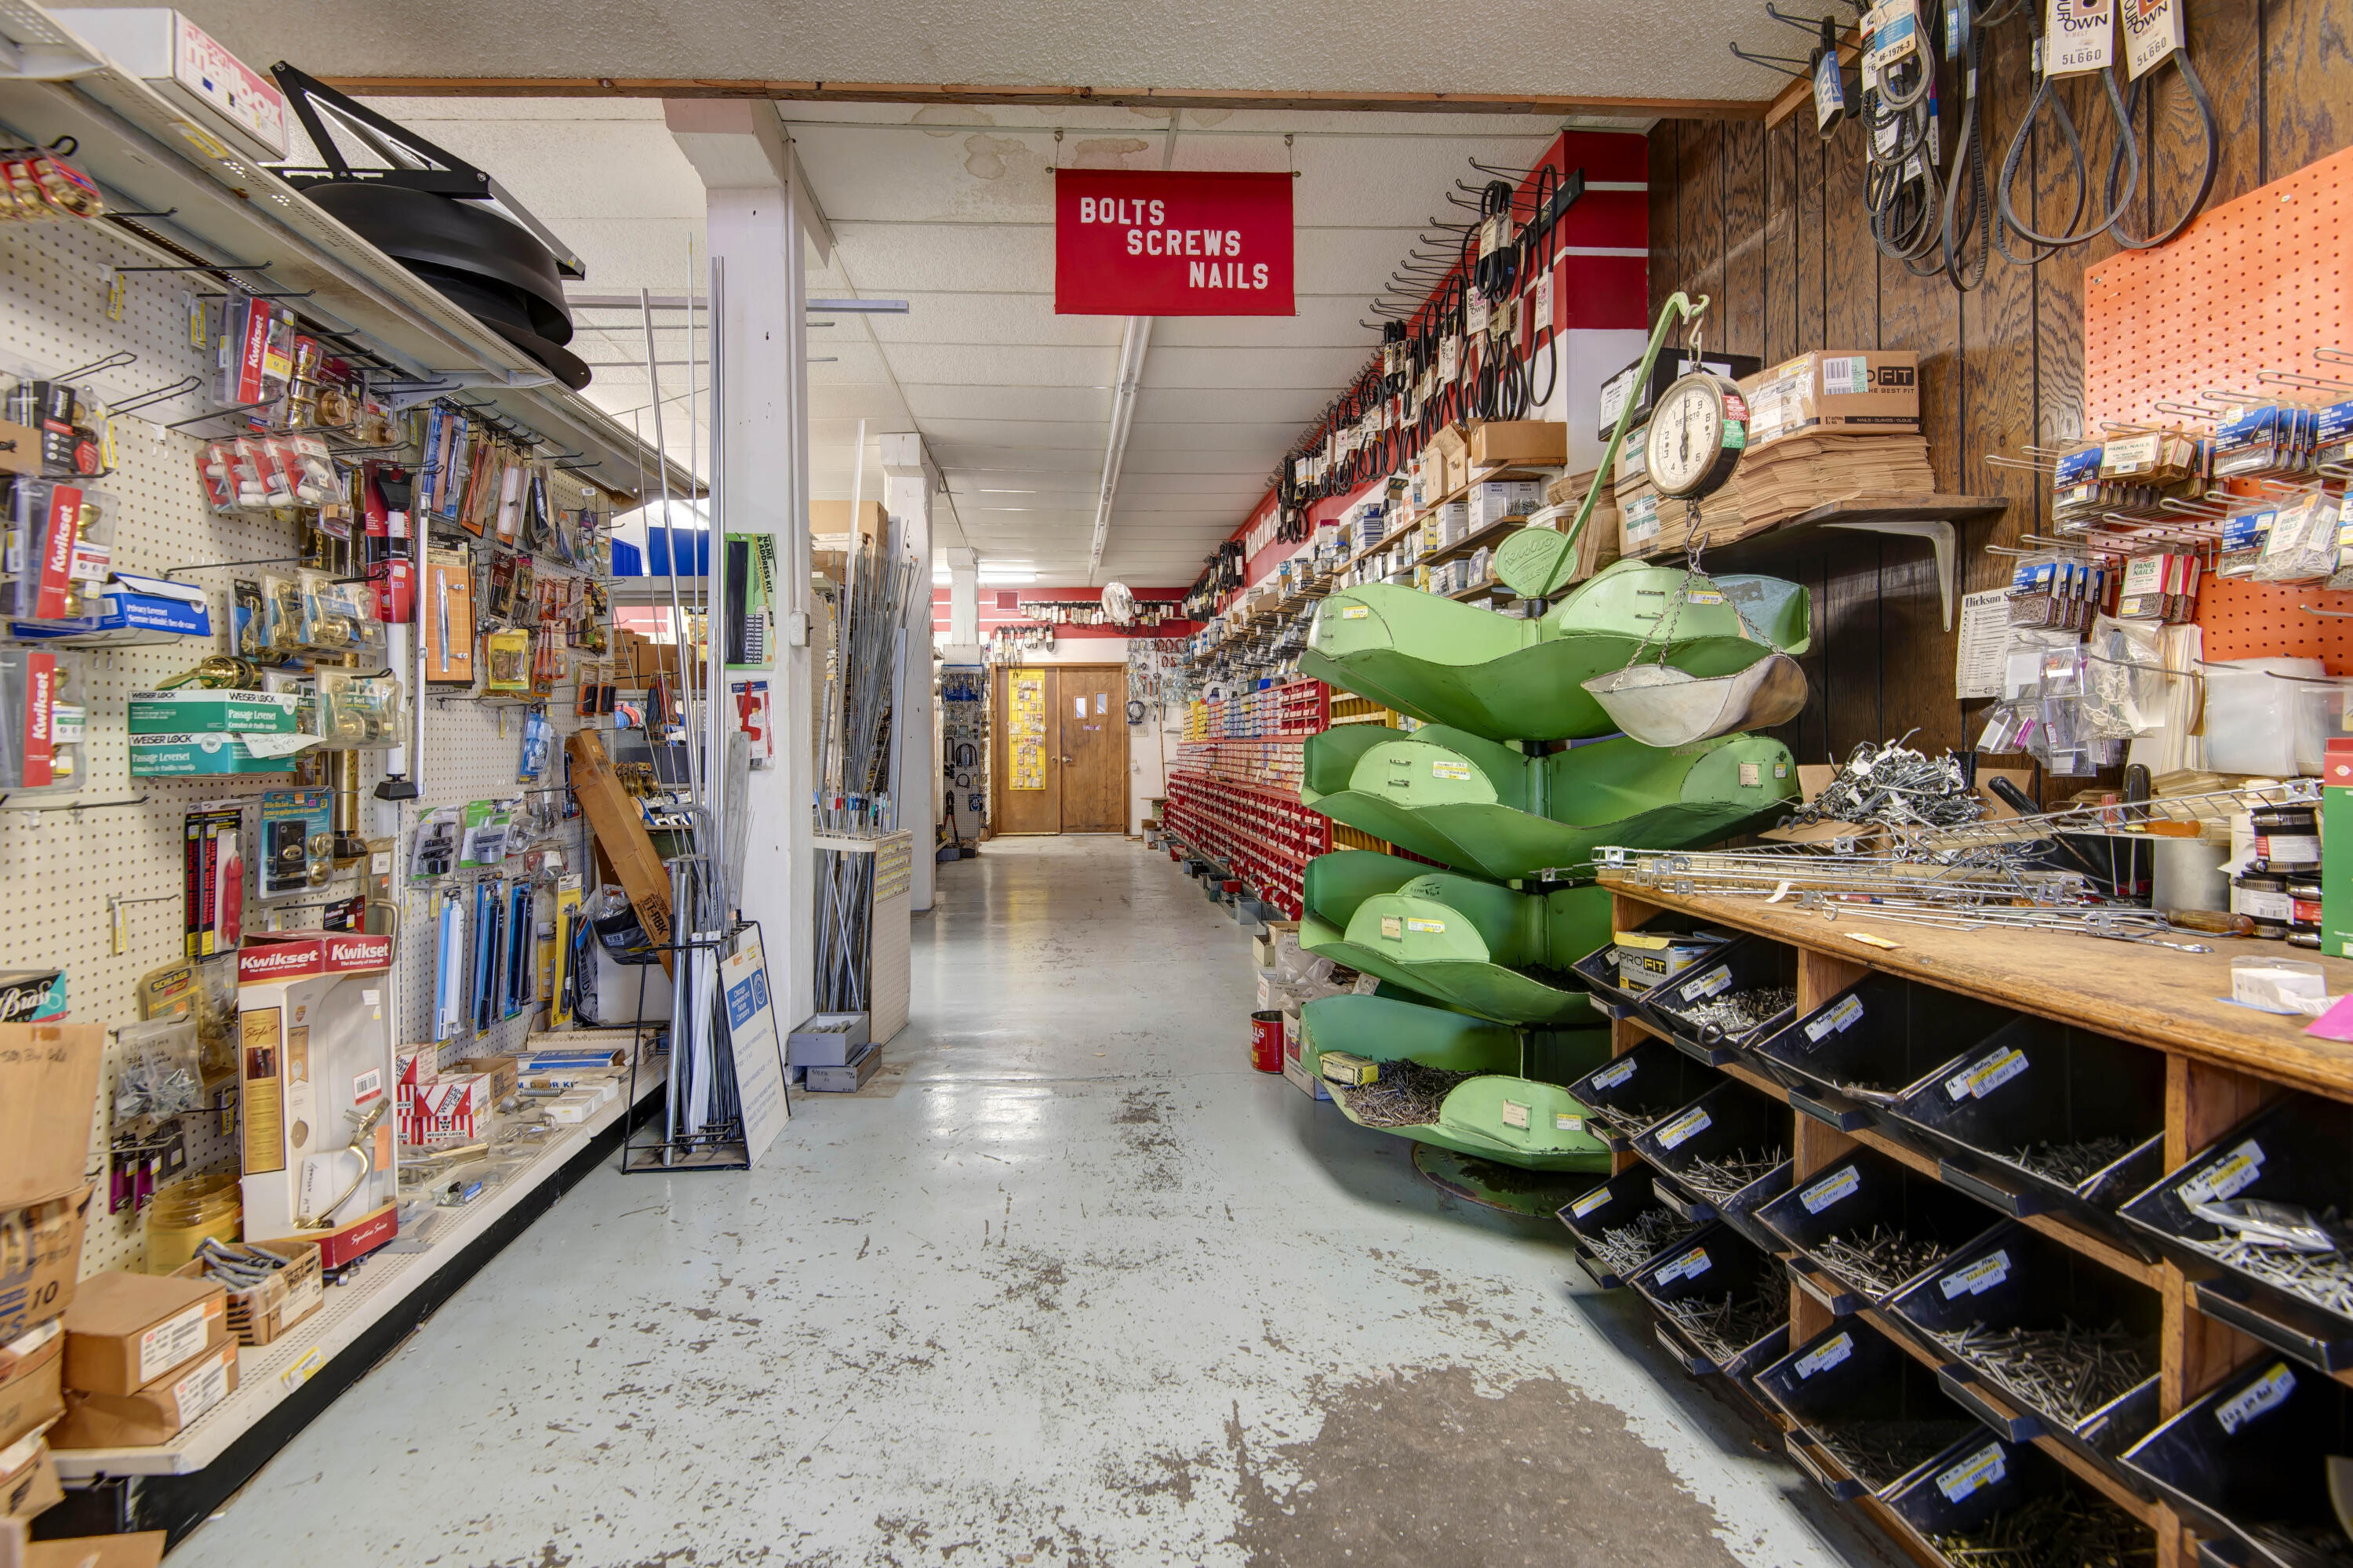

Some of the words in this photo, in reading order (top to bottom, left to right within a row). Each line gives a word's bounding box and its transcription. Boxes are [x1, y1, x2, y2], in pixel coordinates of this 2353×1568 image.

[2057, 0, 2071, 22] UR
[2064, 13, 2108, 31] OWN
[2133, 2, 2167, 34] OWN
[2062, 49, 2101, 65] 5L660
[2137, 37, 2166, 67] 5L660
[1080, 197, 1165, 226] BOLTS
[1127, 229, 1241, 256] SCREWS
[1189, 260, 1268, 289] NAILS
[248, 315, 264, 368] Kwikset
[1881, 369, 1911, 384] FIT
[1675, 410, 1700, 427] DEECTO
[50, 504, 73, 573] Kwikset
[763, 537, 773, 560] NAME
[758, 543, 770, 580] ADDRESS
[2133, 562, 2156, 570] PANEL
[1966, 595, 2000, 608] Dickson
[32, 671, 49, 740] Kwikset
[132, 735, 166, 744] WEISER
[167, 734, 193, 743] LOCK
[240, 949, 318, 970] Kwikset
[330, 943, 389, 962] Kwikset
[1620, 951, 1643, 967] PRO
[1644, 957, 1665, 973] FIT
[439, 1086, 459, 1113] WEISER
[32, 1280, 59, 1311] 10
